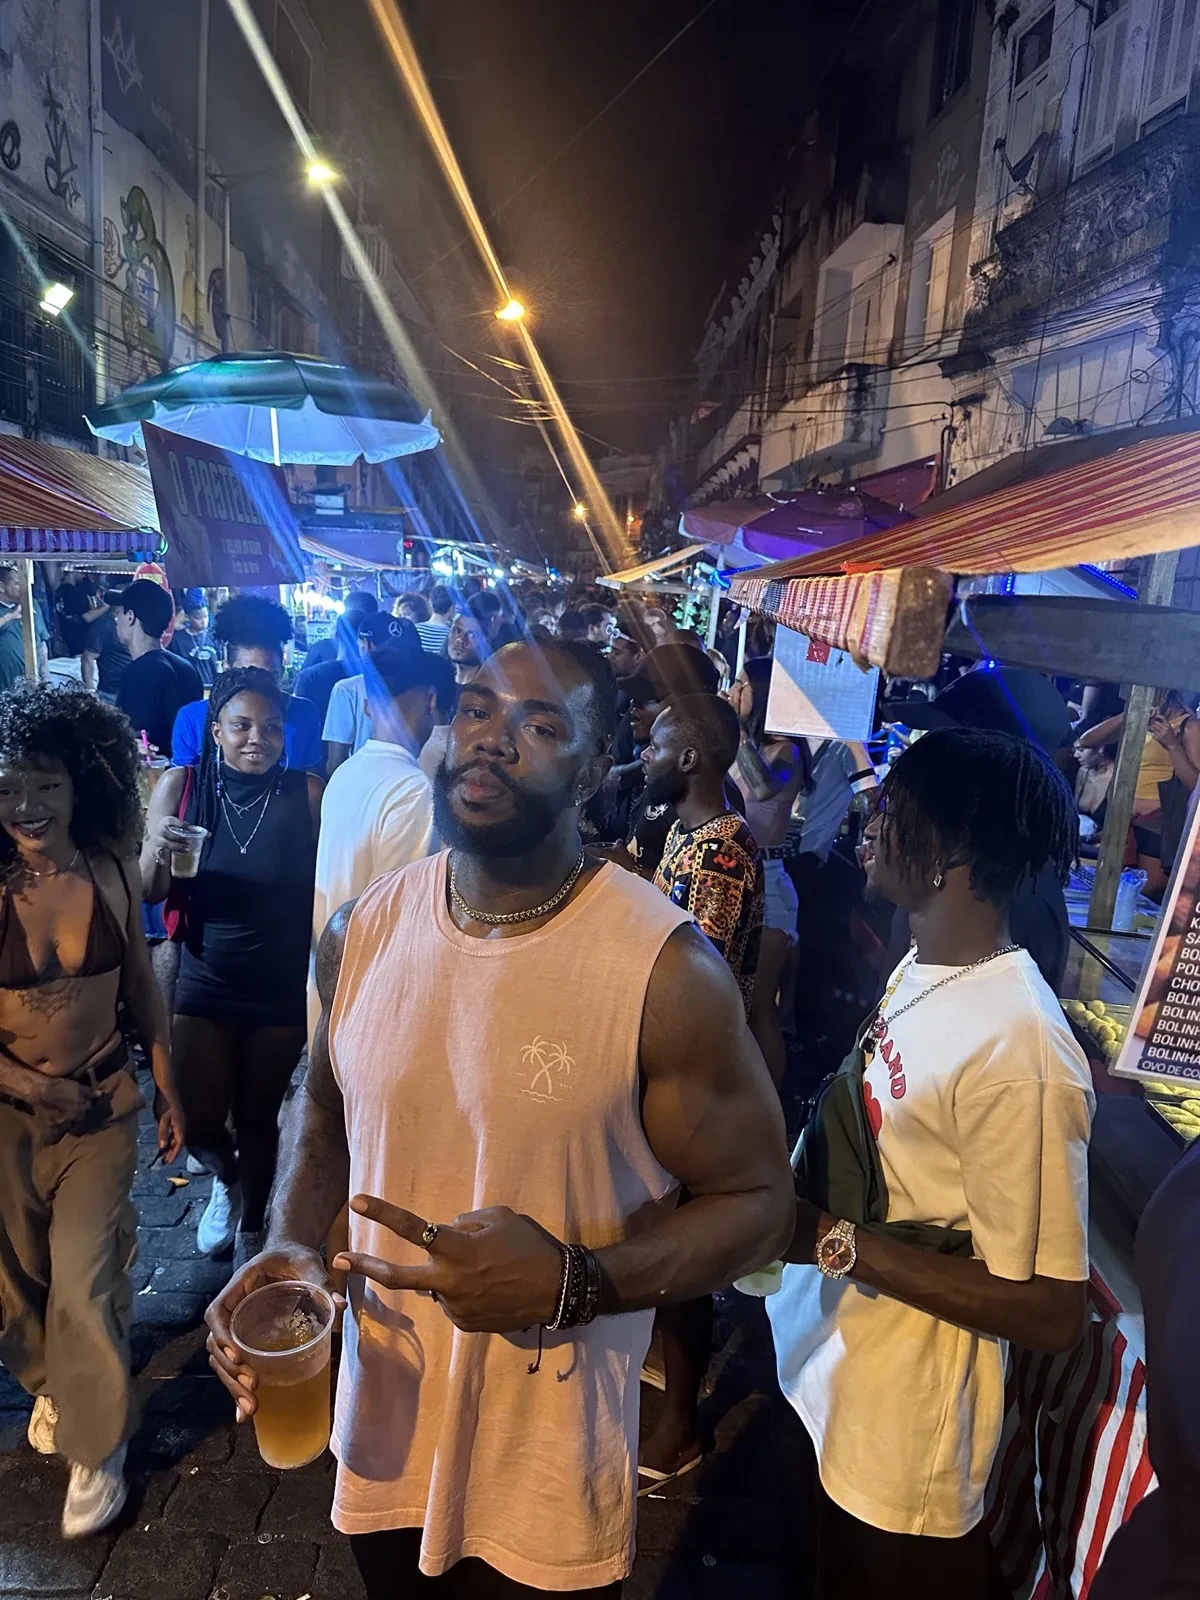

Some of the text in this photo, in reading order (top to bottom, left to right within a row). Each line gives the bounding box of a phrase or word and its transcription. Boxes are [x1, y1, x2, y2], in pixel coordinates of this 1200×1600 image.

[1180, 947, 1200, 961] BO
[1161, 1005, 1200, 1021] BOLIN
[1147, 1046, 1200, 1065] BOLINHA
[1142, 1060, 1200, 1079] OVO DE CO
